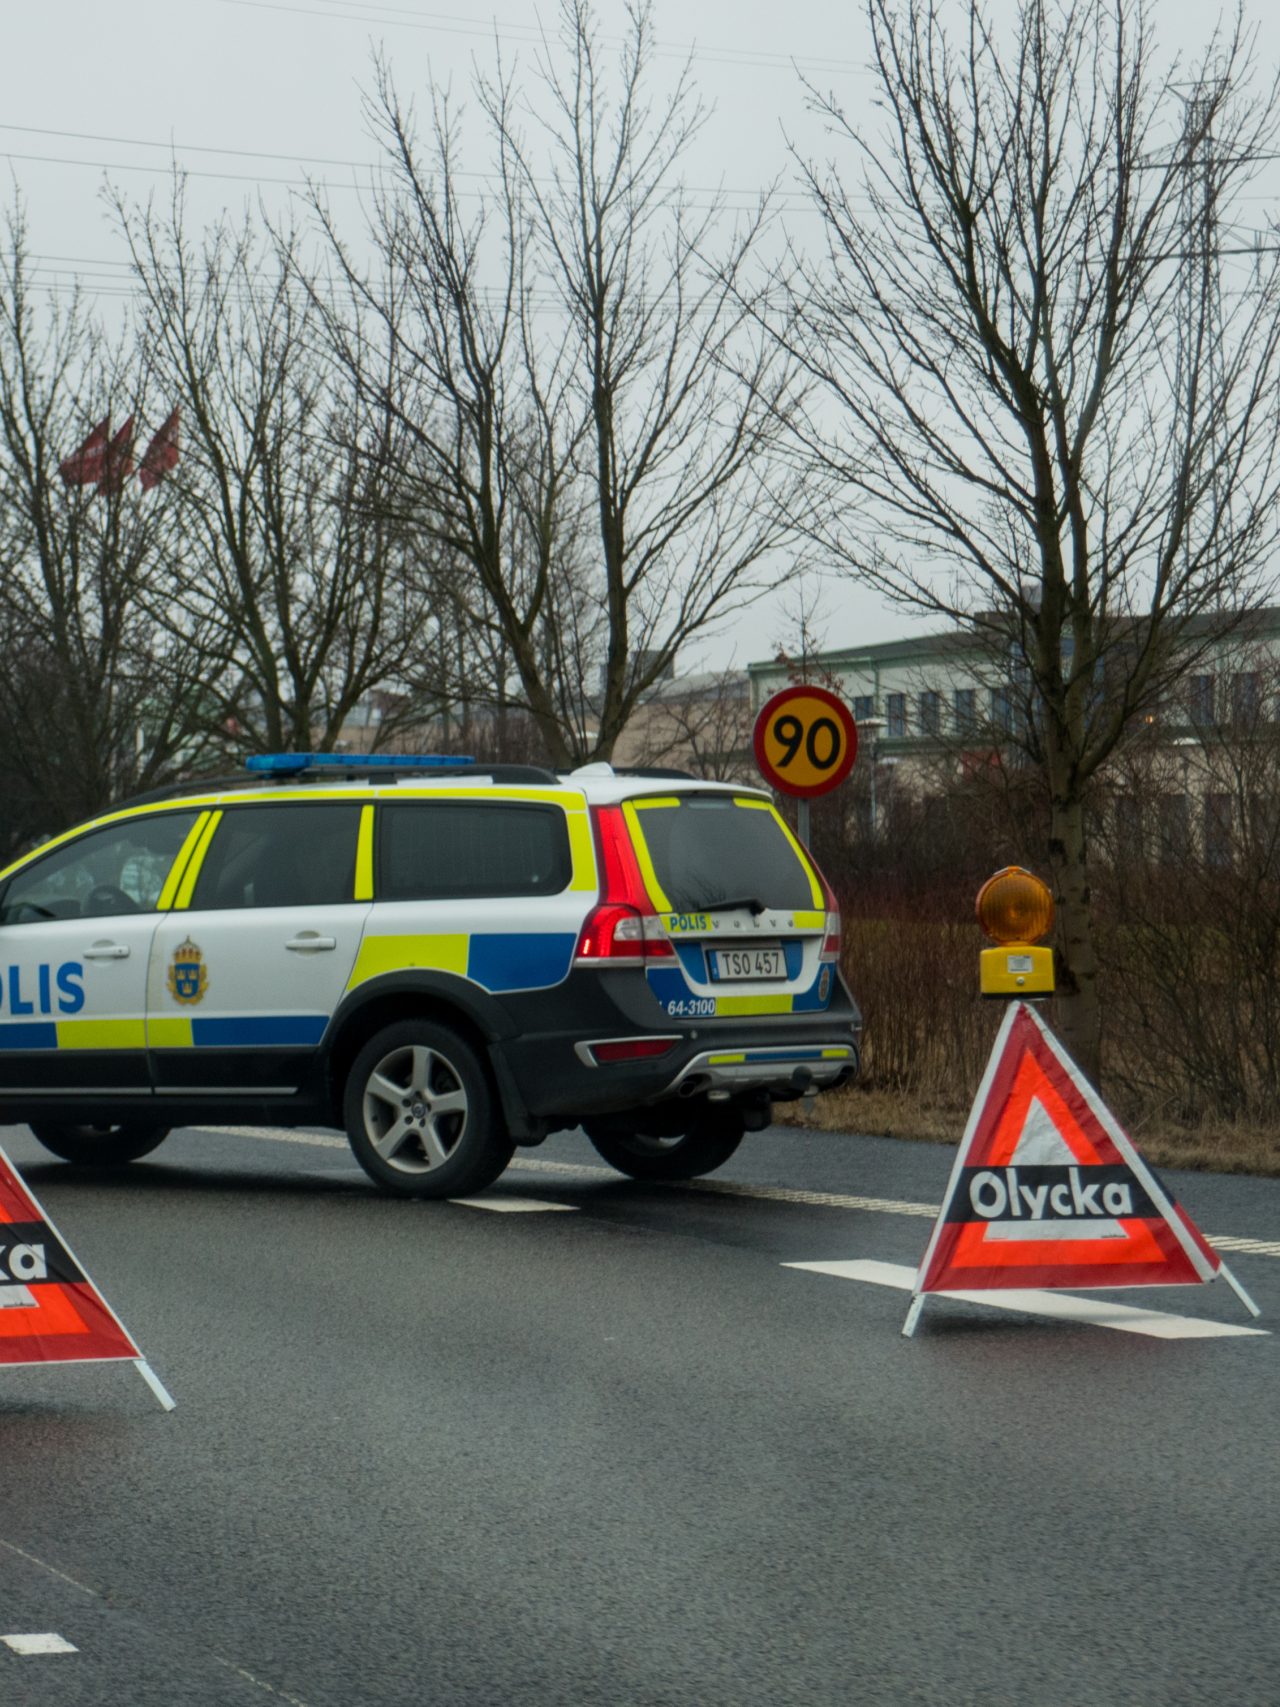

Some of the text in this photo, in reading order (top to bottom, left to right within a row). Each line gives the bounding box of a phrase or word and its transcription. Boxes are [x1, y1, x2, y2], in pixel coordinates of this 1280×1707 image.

[773, 714, 841, 770] 90
[670, 916, 707, 930] POLIS
[722, 952, 780, 976] TSO 457
[667, 999, 716, 1016] 64-3100
[969, 1167, 1133, 1219] Olycka
